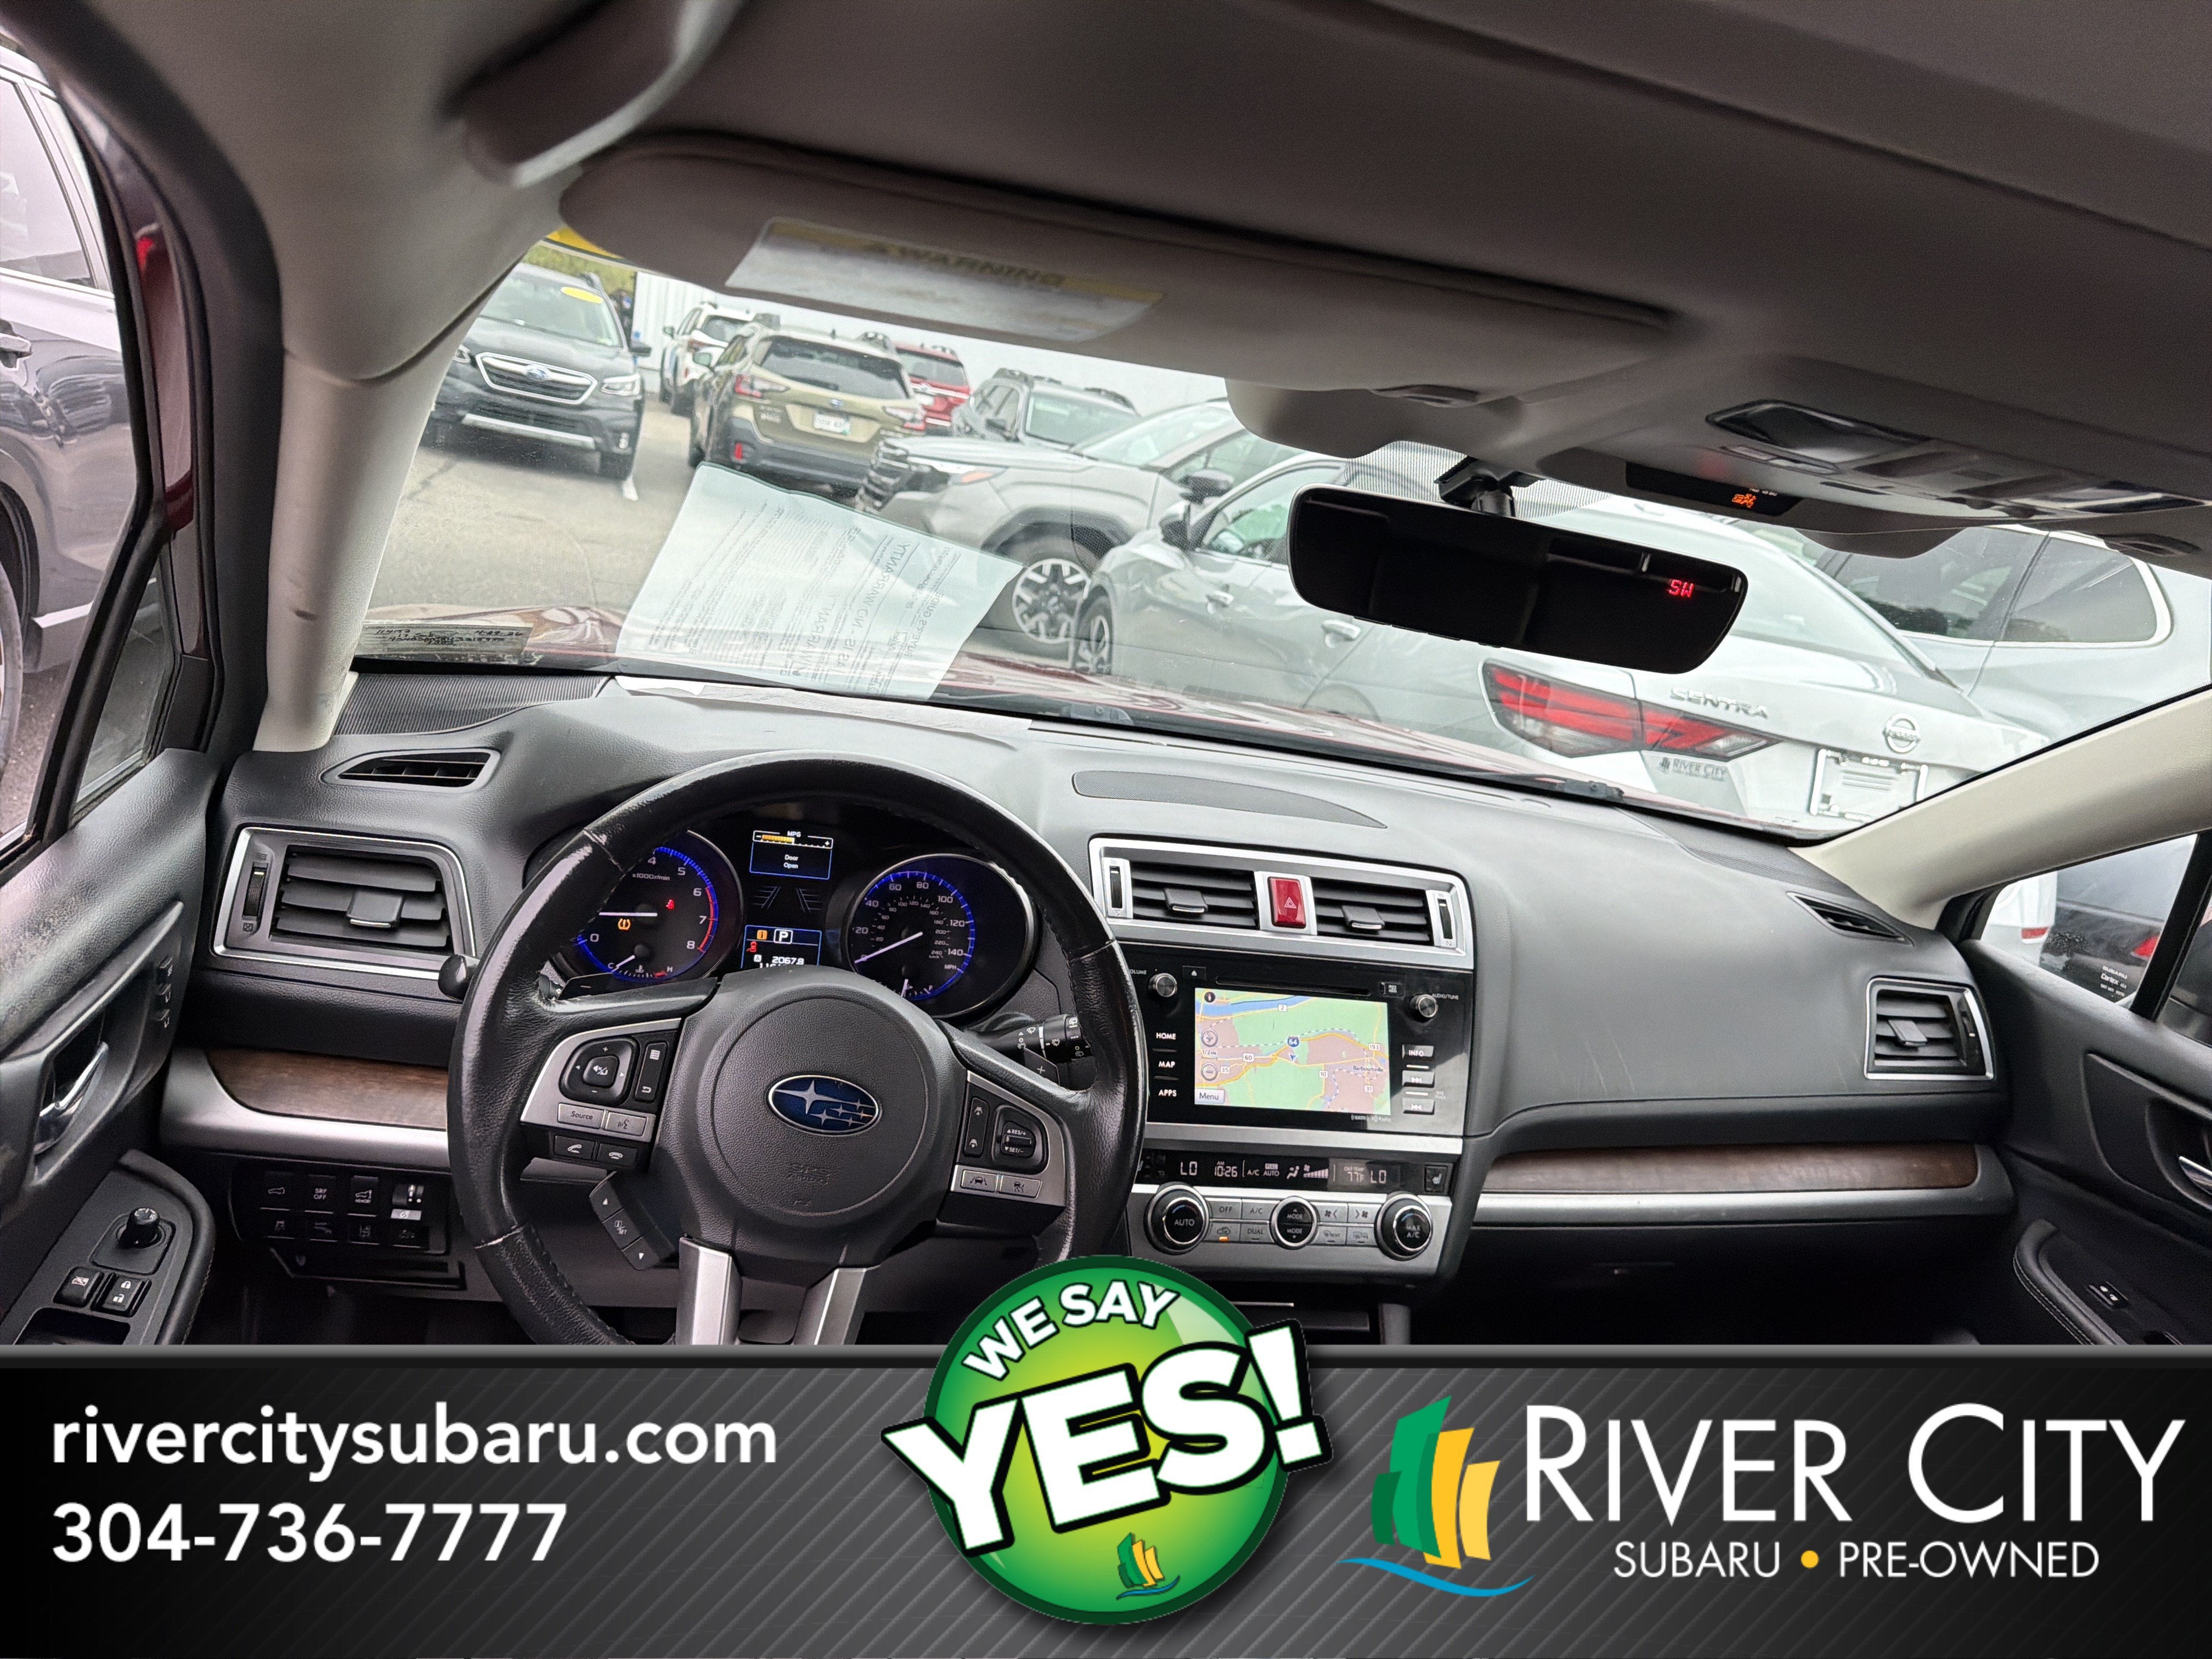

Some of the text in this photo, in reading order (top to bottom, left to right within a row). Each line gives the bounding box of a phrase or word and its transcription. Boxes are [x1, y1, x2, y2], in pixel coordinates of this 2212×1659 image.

[1668, 579, 1695, 598] SW
[1670, 687, 1768, 719] SENTRA
[1673, 758, 1701, 771] RIVER
[1704, 764, 1728, 776] CITY
[648, 856, 656, 865] 4
[678, 867, 686, 876] 5
[693, 888, 702, 896] 6
[699, 916, 707, 924] 7
[590, 933, 599, 942] 0
[778, 932, 788, 942] P
[686, 940, 695, 949] 8
[571, 1111, 593, 1120] Source
[1214, 1166, 1238, 1177] 10:26
